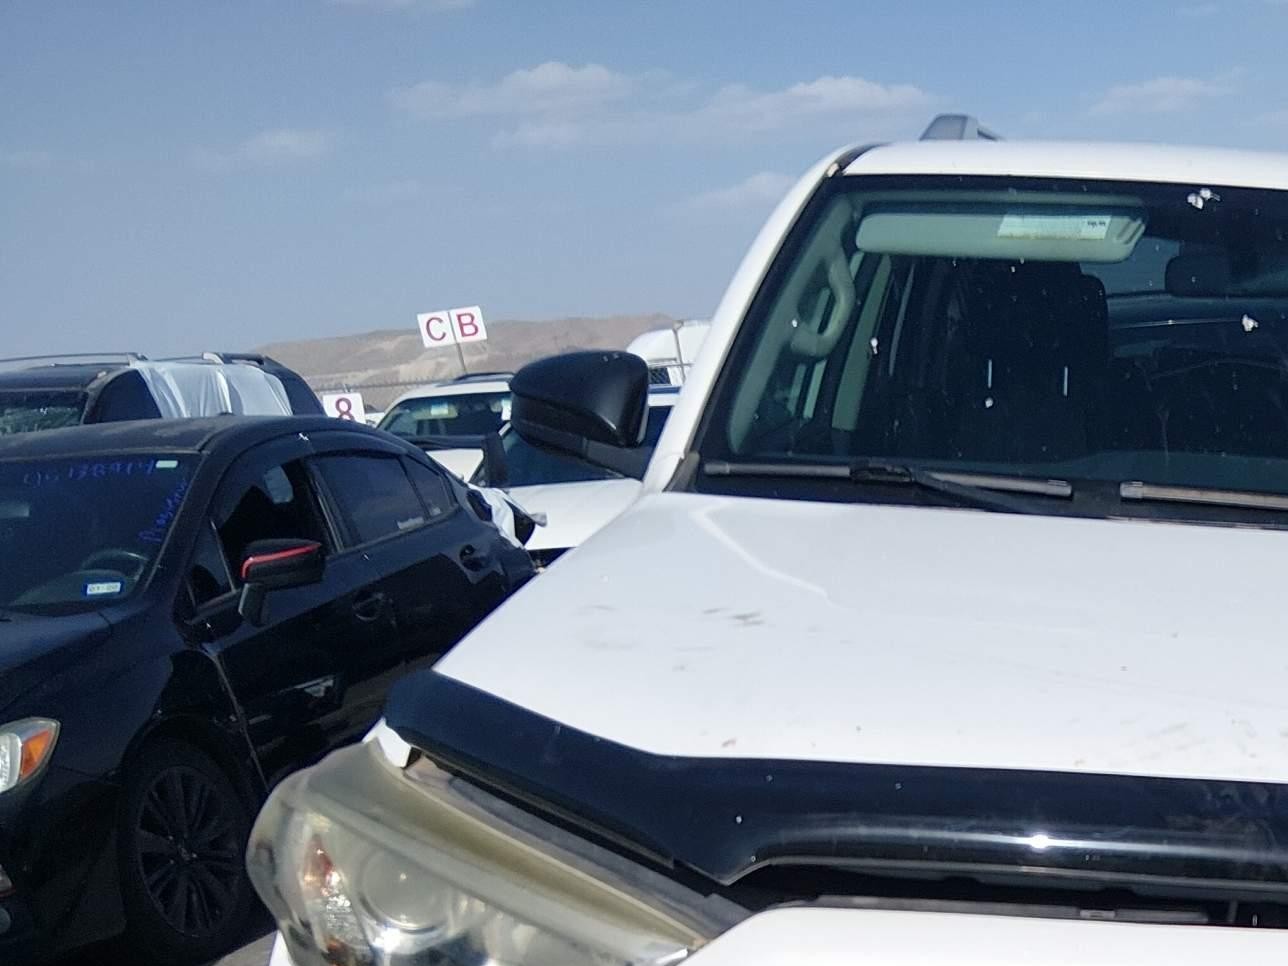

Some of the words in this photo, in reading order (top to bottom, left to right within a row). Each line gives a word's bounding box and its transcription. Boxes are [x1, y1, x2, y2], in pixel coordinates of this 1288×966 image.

[425, 316, 447, 341] C
[456, 312, 479, 338] B
[335, 397, 355, 421] 8
